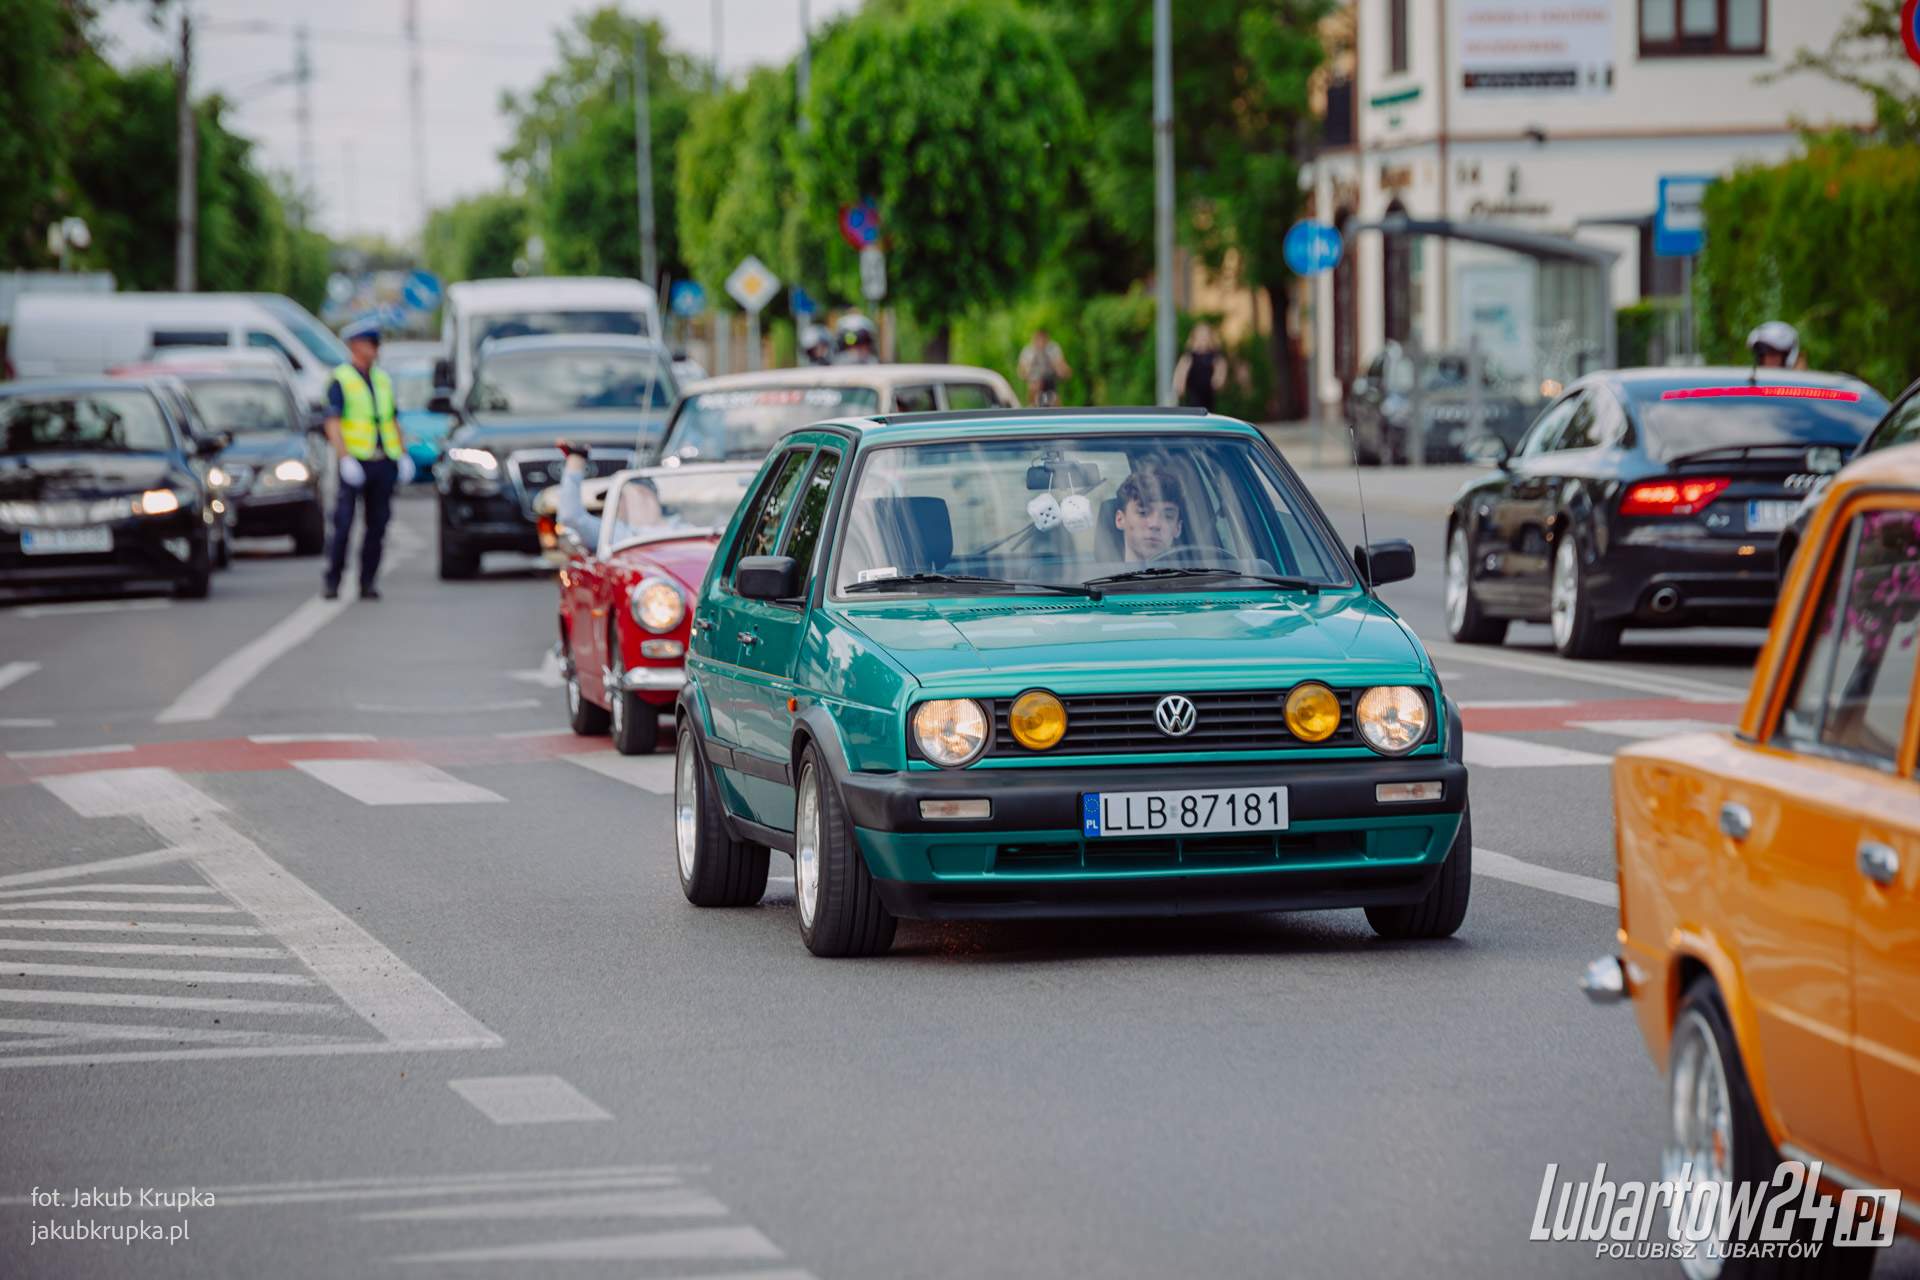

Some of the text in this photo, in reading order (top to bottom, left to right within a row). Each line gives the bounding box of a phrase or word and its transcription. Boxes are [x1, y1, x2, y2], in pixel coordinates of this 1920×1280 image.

[1156, 695, 1197, 736] VW
[1086, 819, 1099, 830] PL
[1104, 792, 1279, 831] LLB 87181
